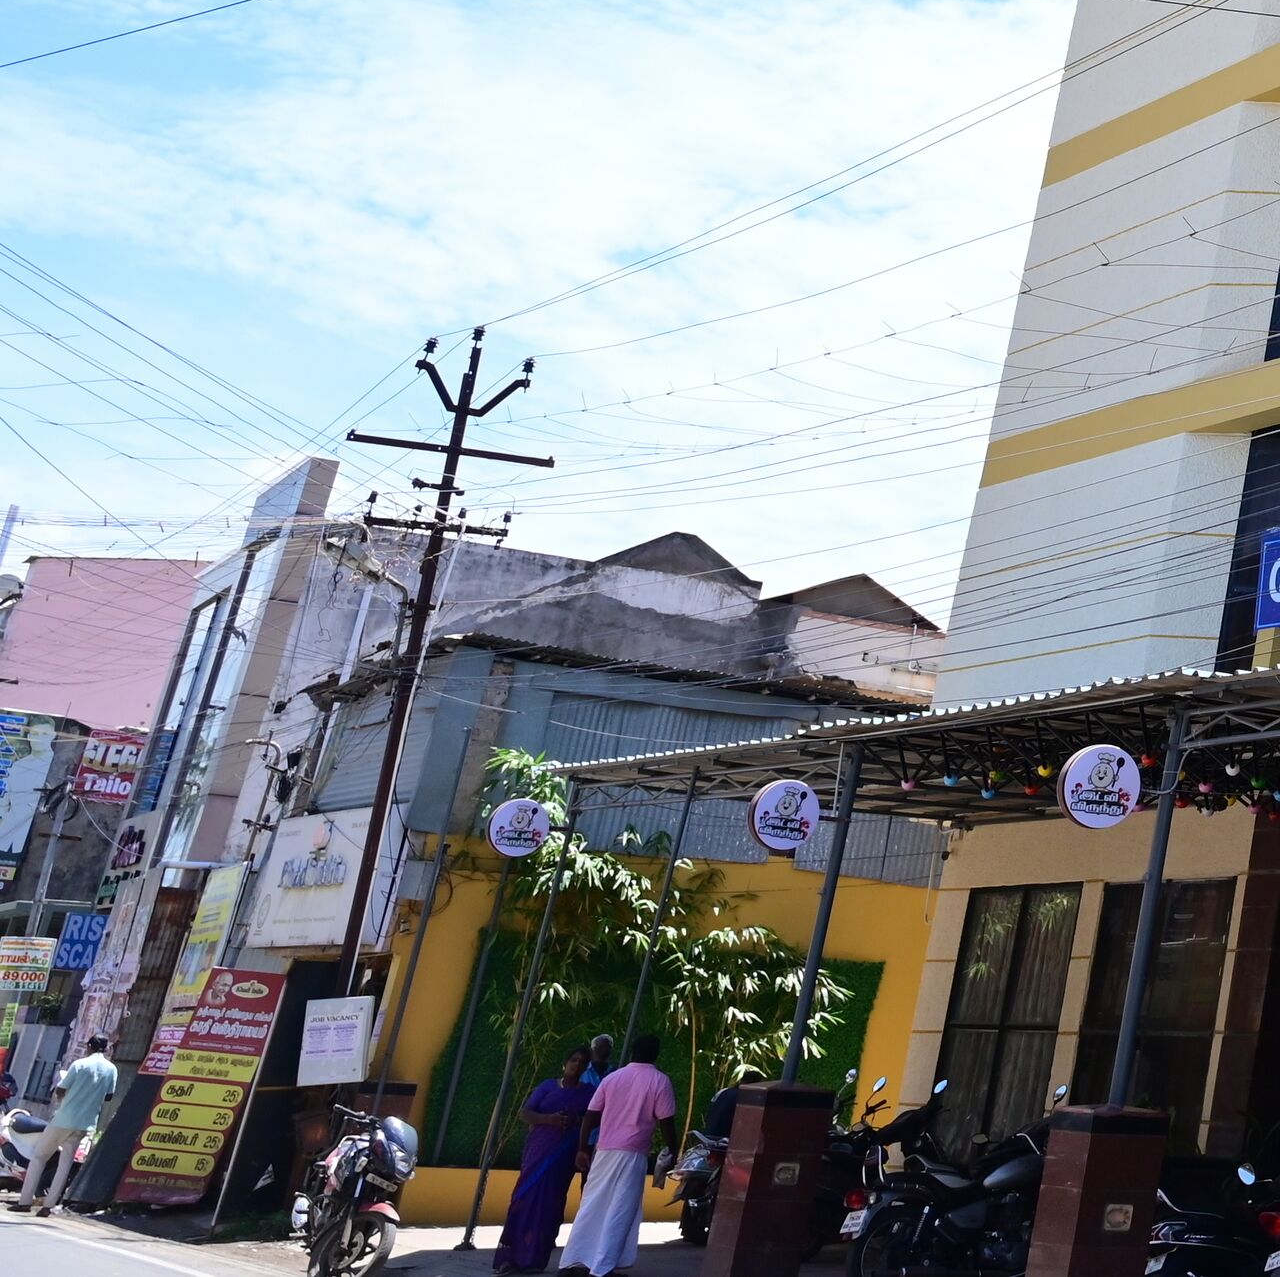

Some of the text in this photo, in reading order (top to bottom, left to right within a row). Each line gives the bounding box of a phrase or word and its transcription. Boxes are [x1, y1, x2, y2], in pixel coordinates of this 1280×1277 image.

[1080, 791, 1119, 802] இட்லி
[1071, 802, 1124, 816] விருந்து
[327, 1014, 360, 1022] VACANCY
[156, 1107, 180, 1122] பட்டு
